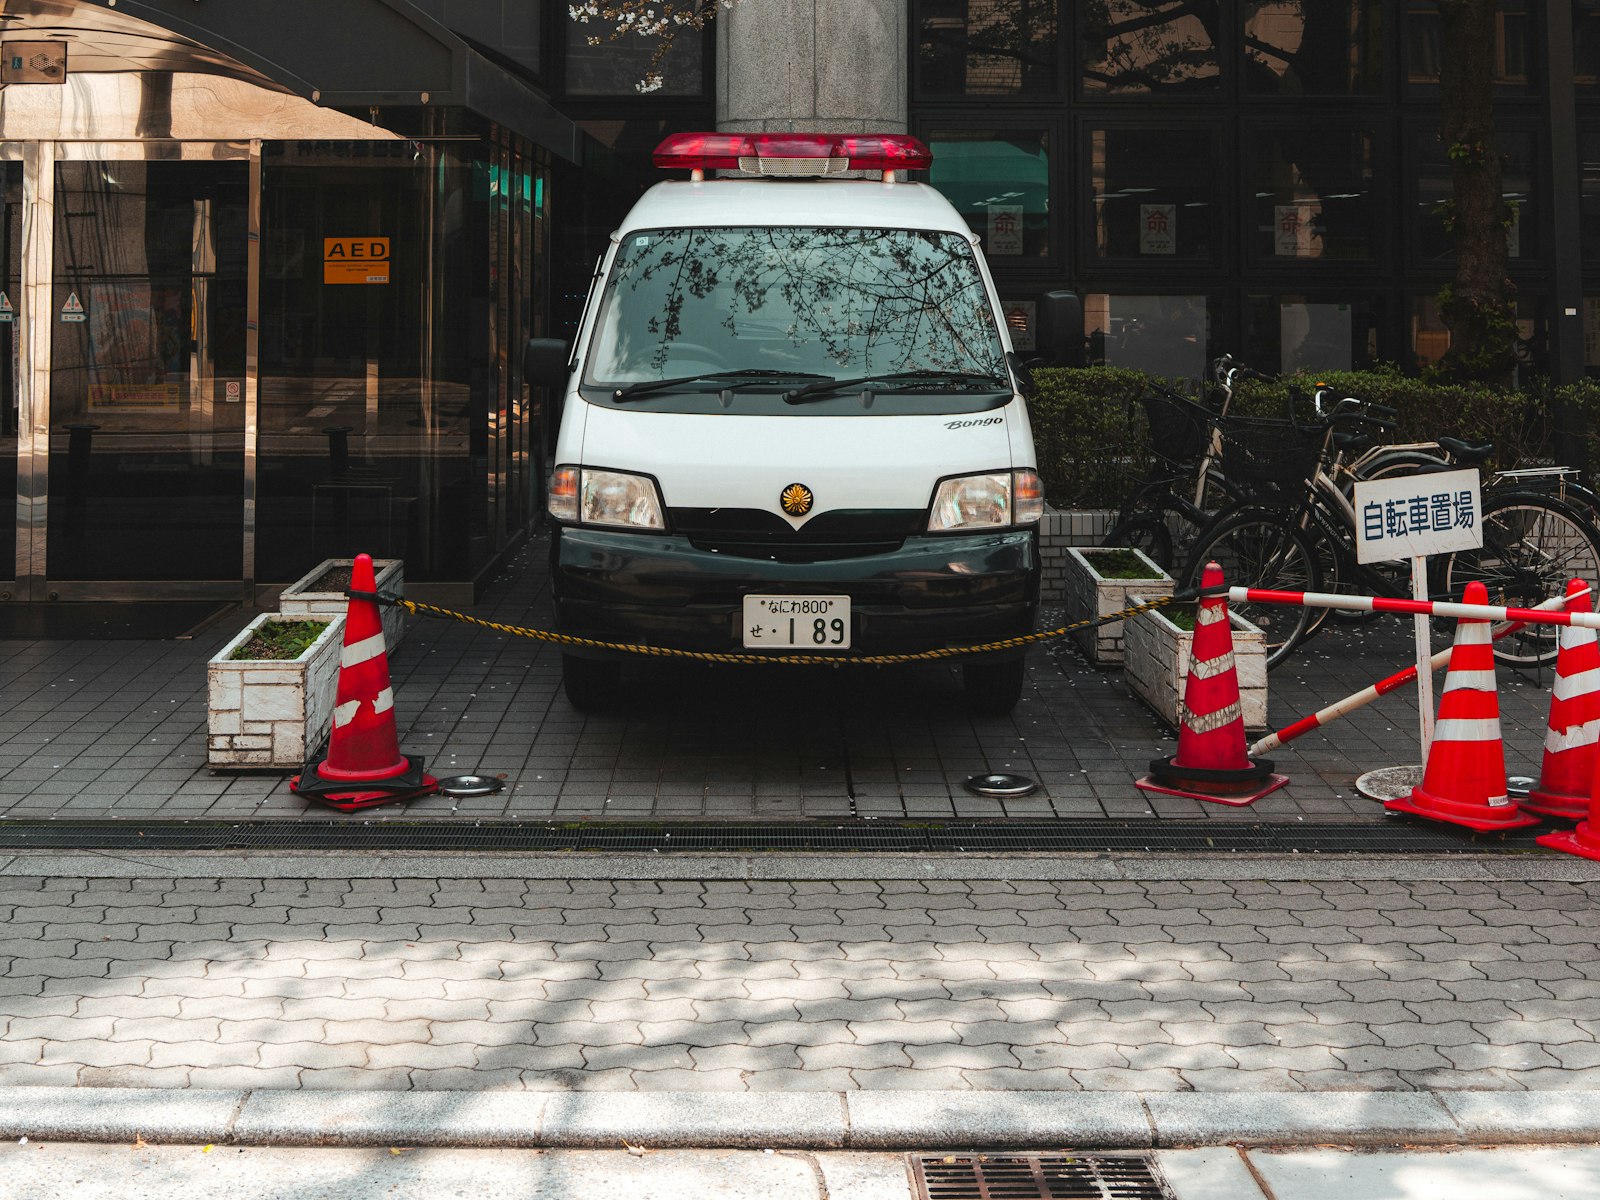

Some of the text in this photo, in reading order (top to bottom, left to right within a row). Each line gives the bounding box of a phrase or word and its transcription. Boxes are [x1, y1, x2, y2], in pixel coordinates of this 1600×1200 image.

[328, 243, 386, 257] AED
[944, 417, 1003, 430] Bongo
[1364, 490, 1474, 540] 自転車置場
